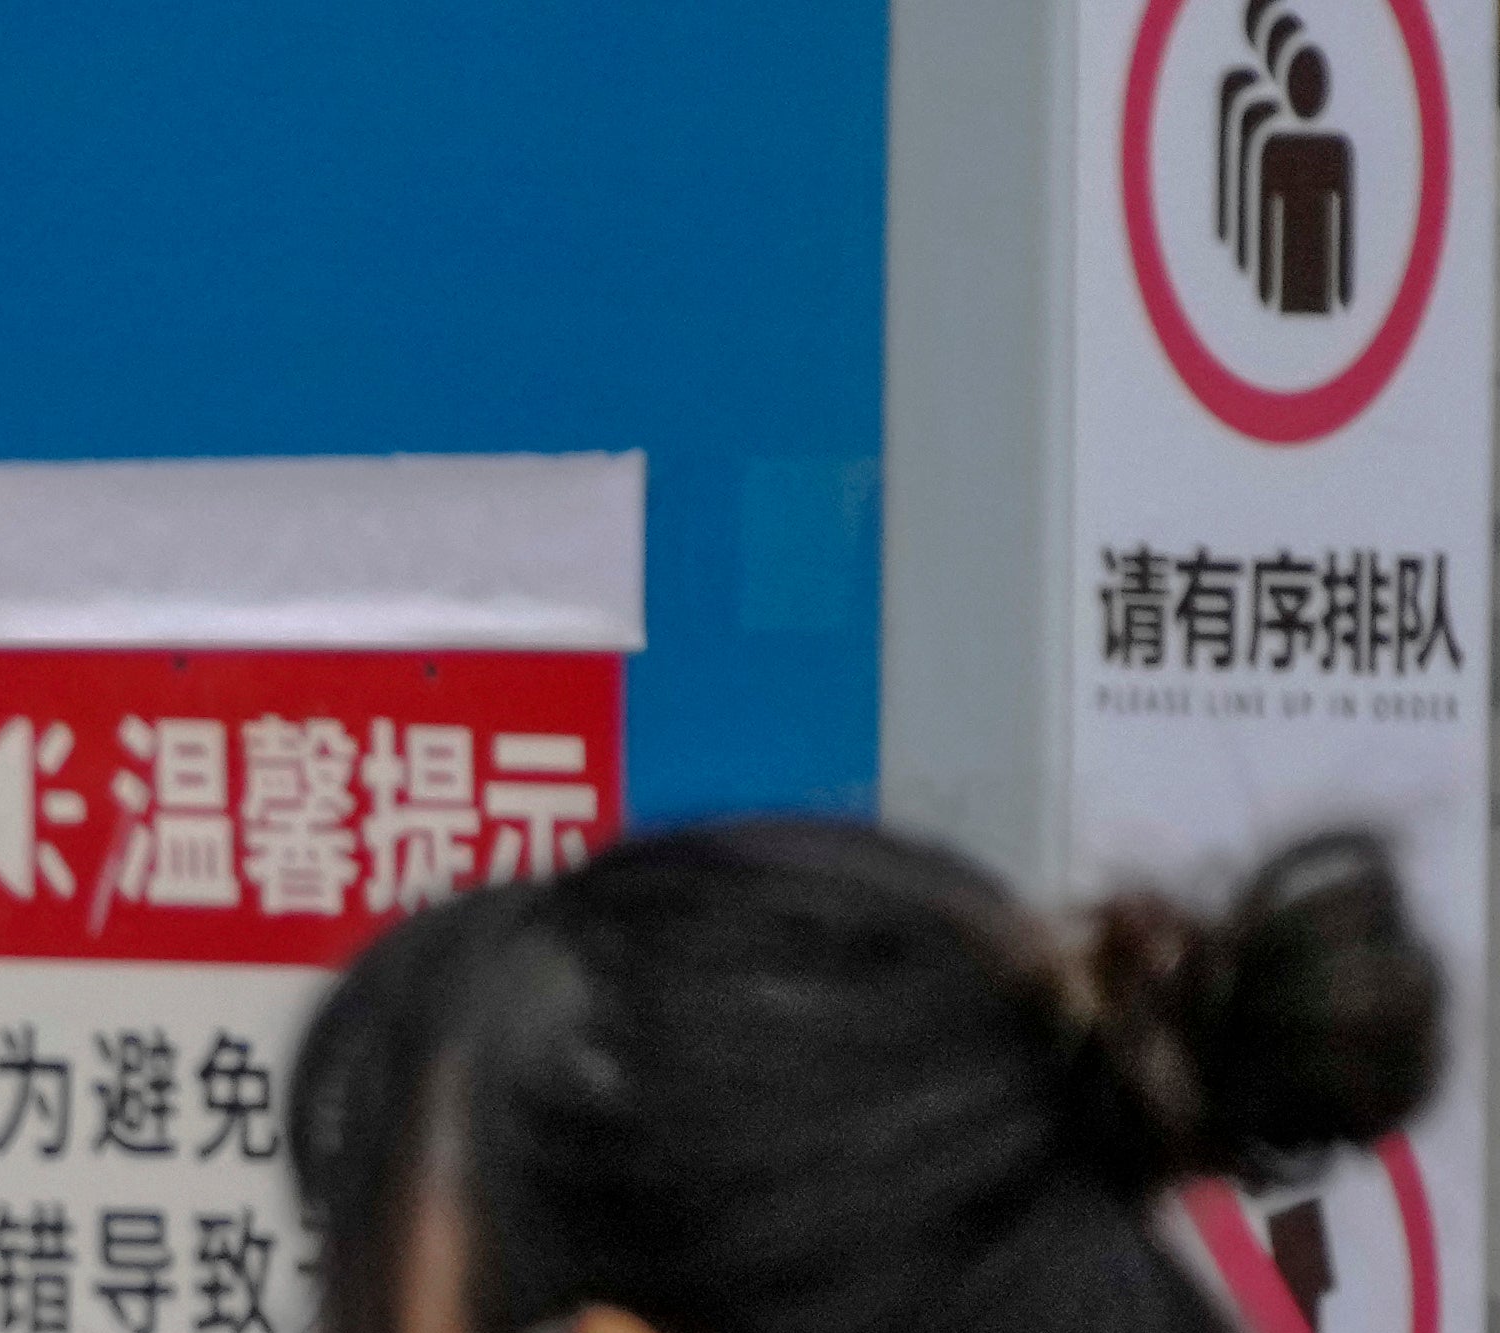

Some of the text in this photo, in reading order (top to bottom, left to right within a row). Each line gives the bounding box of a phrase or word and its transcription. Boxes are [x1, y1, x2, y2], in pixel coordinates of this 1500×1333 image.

[1099, 545, 1464, 675] 请有序排队
[1096, 687, 1460, 722] PLEASE LINE UP IN ORDER
[110, 714, 598, 918] 温馨提示
